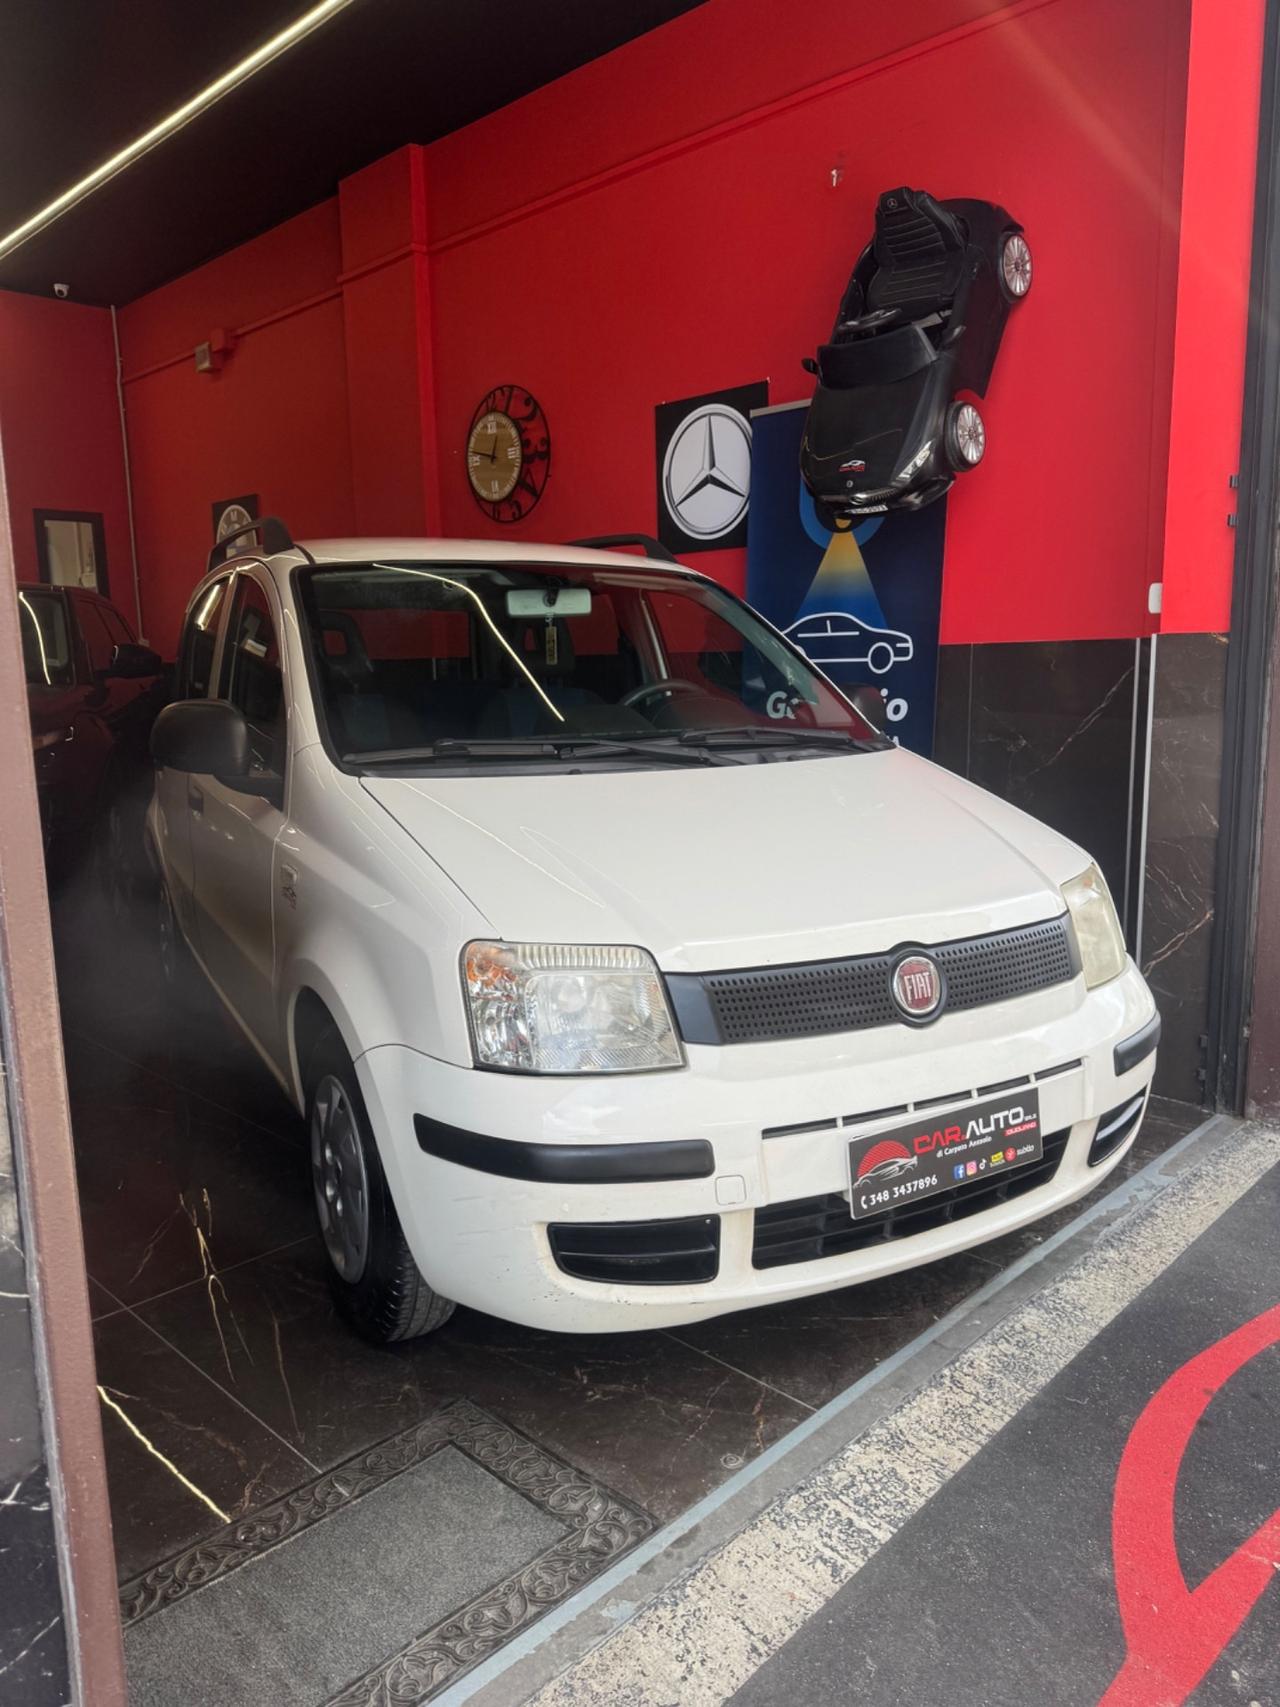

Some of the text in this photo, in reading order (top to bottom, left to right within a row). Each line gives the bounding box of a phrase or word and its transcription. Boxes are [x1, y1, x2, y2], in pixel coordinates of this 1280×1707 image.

[903, 971, 931, 1002] FIAT
[869, 1174, 938, 1206] 348 3437896
